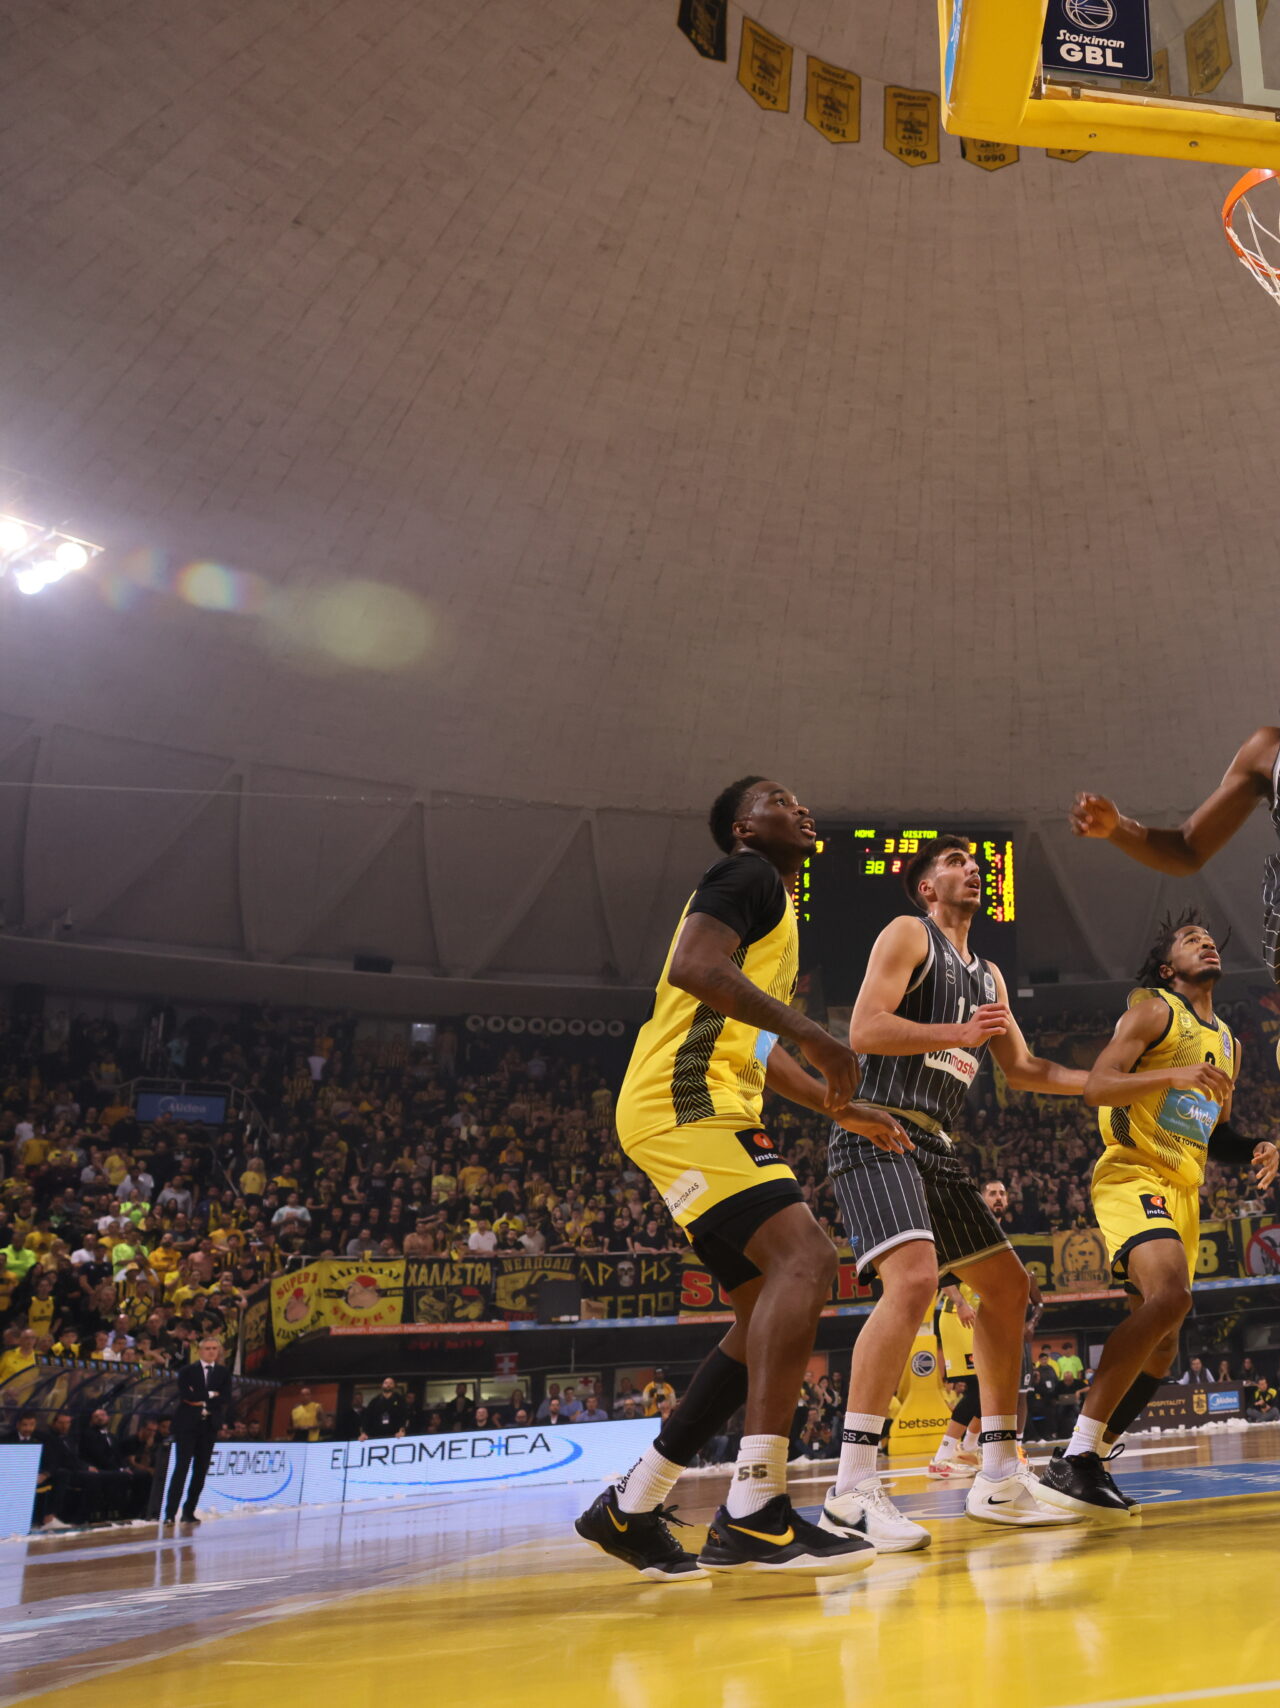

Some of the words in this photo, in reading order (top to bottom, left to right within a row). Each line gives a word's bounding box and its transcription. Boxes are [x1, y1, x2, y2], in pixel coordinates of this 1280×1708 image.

[1056, 29, 1125, 49] Stoiximan
[1059, 43, 1124, 69] GBL
[819, 120, 847, 138] 1991
[898, 147, 927, 160] 1990
[976, 153, 1006, 162] 1990
[854, 829, 876, 838] HOME
[902, 830, 938, 839] VISITOR
[865, 860, 885, 875] 38
[892, 860, 902, 873] 2
[406, 1262, 492, 1287] ΧΑΛΑΣΤΡΑ
[1146, 1399, 1187, 1408] HOSPITALITY
[1147, 1407, 1187, 1417] AREA
[985, 1432, 1013, 1441] GSA
[737, 1463, 768, 1482] 55
